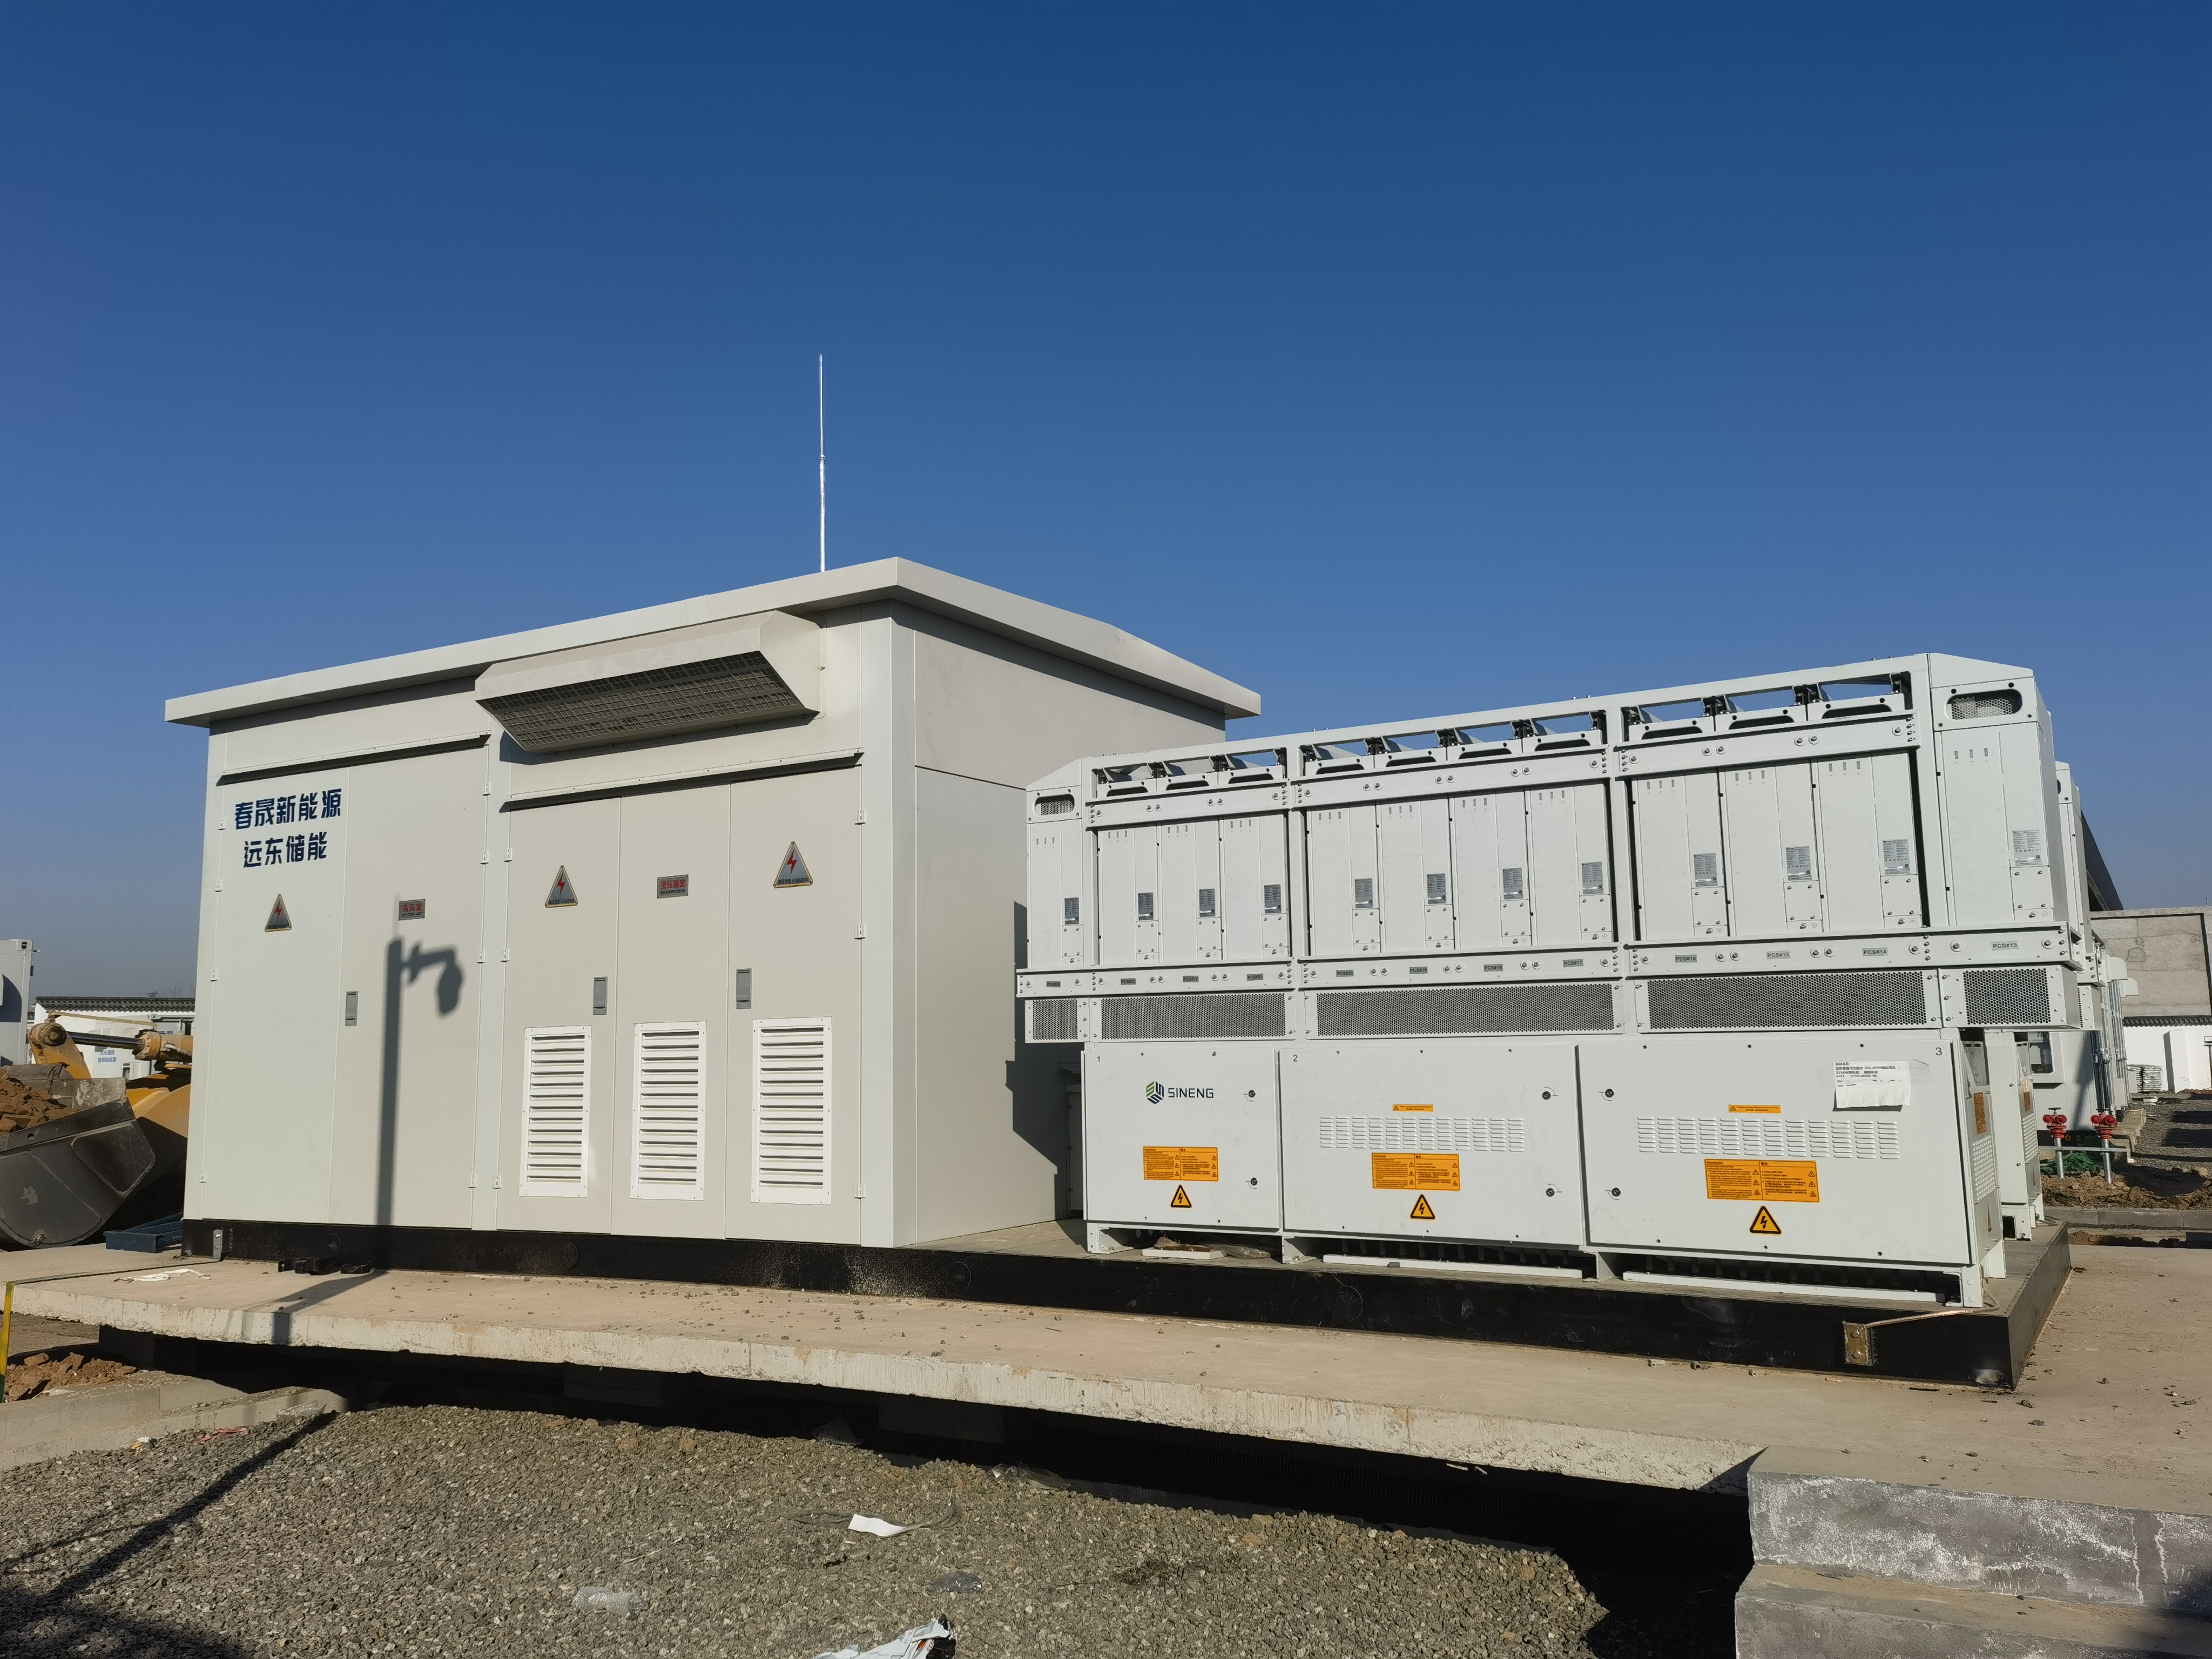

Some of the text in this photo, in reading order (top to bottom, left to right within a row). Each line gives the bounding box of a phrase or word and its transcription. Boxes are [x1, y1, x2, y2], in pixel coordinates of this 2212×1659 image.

[234, 788, 342, 830] 春晟新能源
[243, 832, 327, 868] 远东储能
[1936, 1048, 1942, 1056] 3
[1168, 1088, 1214, 1098] SINENG
